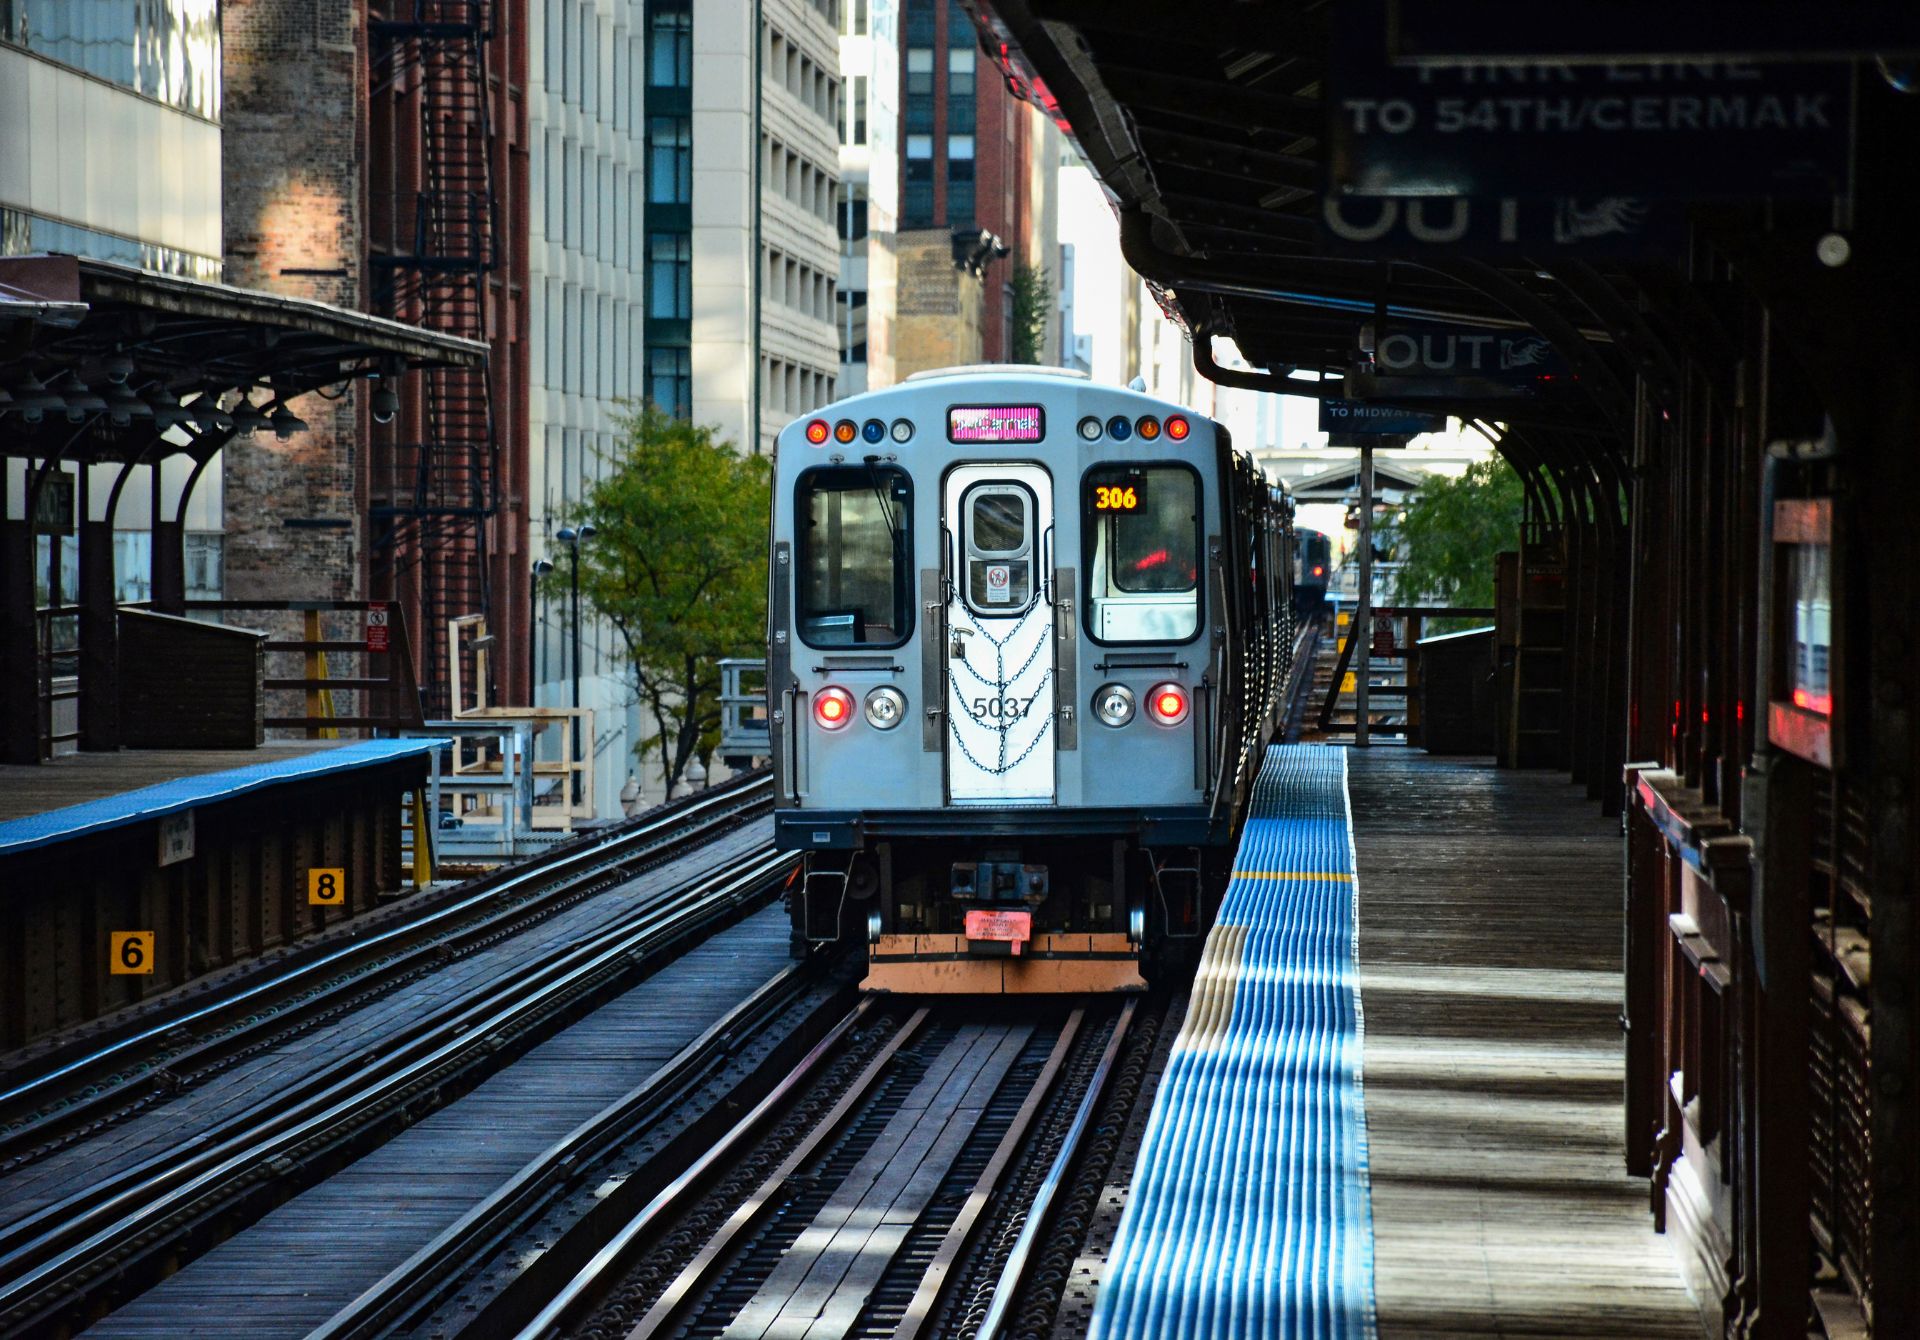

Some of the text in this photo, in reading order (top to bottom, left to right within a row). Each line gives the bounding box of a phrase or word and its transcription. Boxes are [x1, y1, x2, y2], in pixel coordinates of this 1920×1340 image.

[1344, 95, 1831, 133] TO 54TH/CERMAK
[1379, 334, 1494, 370] OUT
[1329, 407, 1349, 417] TO
[1096, 486, 1137, 510] 306
[973, 697, 1033, 718] 5037
[316, 873, 336, 899] 8
[120, 937, 144, 968] 6
